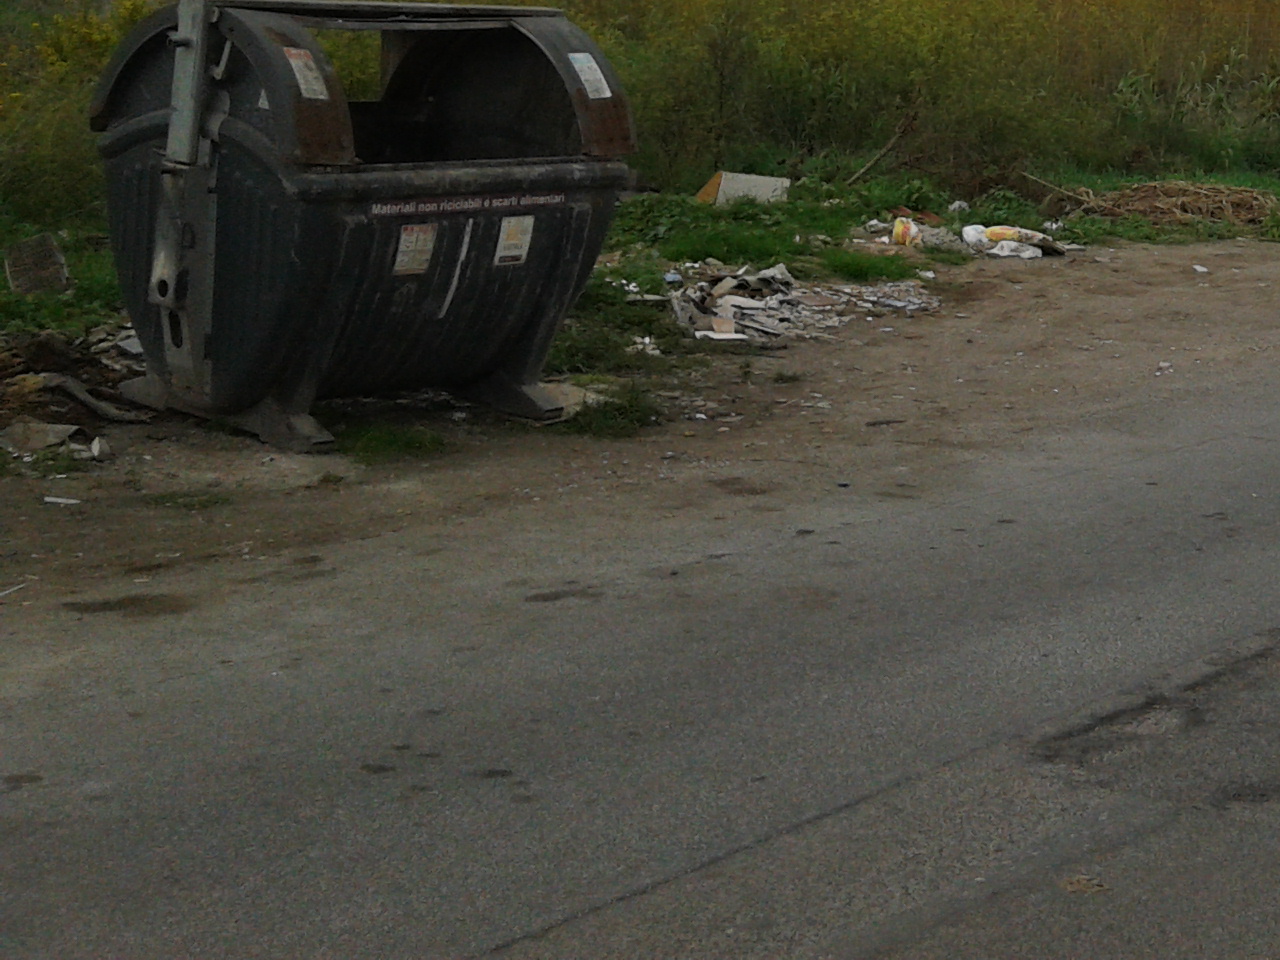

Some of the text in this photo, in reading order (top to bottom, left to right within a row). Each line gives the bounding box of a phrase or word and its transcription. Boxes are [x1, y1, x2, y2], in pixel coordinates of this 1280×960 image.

[371, 201, 417, 214] Materiali
[418, 202, 438, 213] non
[439, 198, 483, 211] riciclabili
[491, 196, 518, 207] scarti
[520, 193, 565, 205] alimentari
